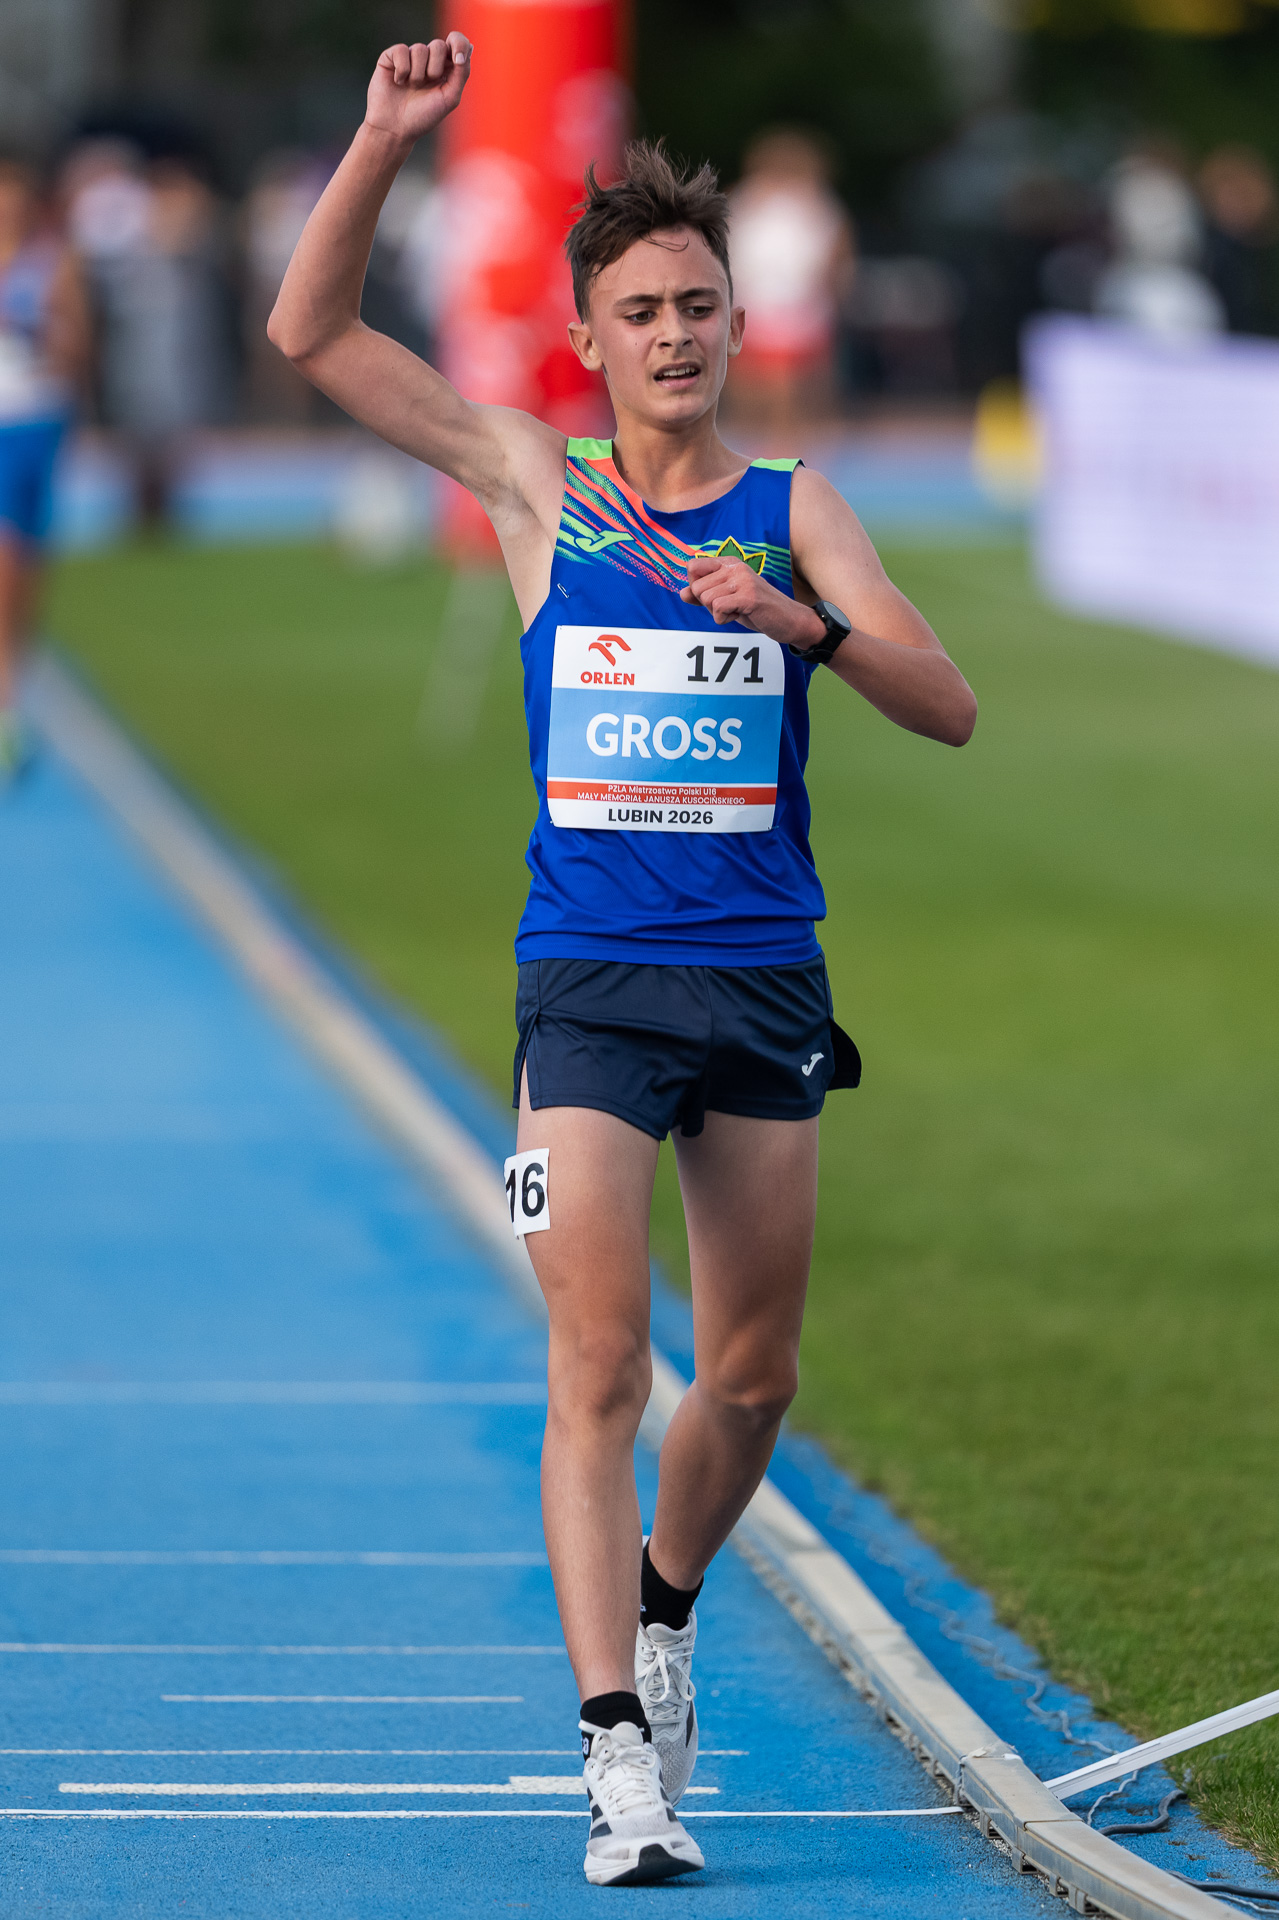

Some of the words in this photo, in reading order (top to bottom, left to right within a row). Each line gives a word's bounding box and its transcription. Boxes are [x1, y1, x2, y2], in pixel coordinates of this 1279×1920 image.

[686, 645, 764, 684] 171
[580, 671, 635, 686] ORLEN
[586, 712, 743, 761] GROSS
[577, 791, 599, 801] MAŁY
[600, 793, 642, 803] MEMORIAŁ
[643, 795, 680, 804] JANUSZA
[682, 795, 745, 805] KUSOCIŃSKIEGO
[608, 784, 627, 793] PZLA
[629, 785, 677, 795] Mistrzostwa
[679, 787, 702, 796] Polski
[703, 788, 717, 796] U16
[608, 808, 663, 823] LUBIN
[667, 810, 714, 825] 2026
[505, 1162, 546, 1223] 16
